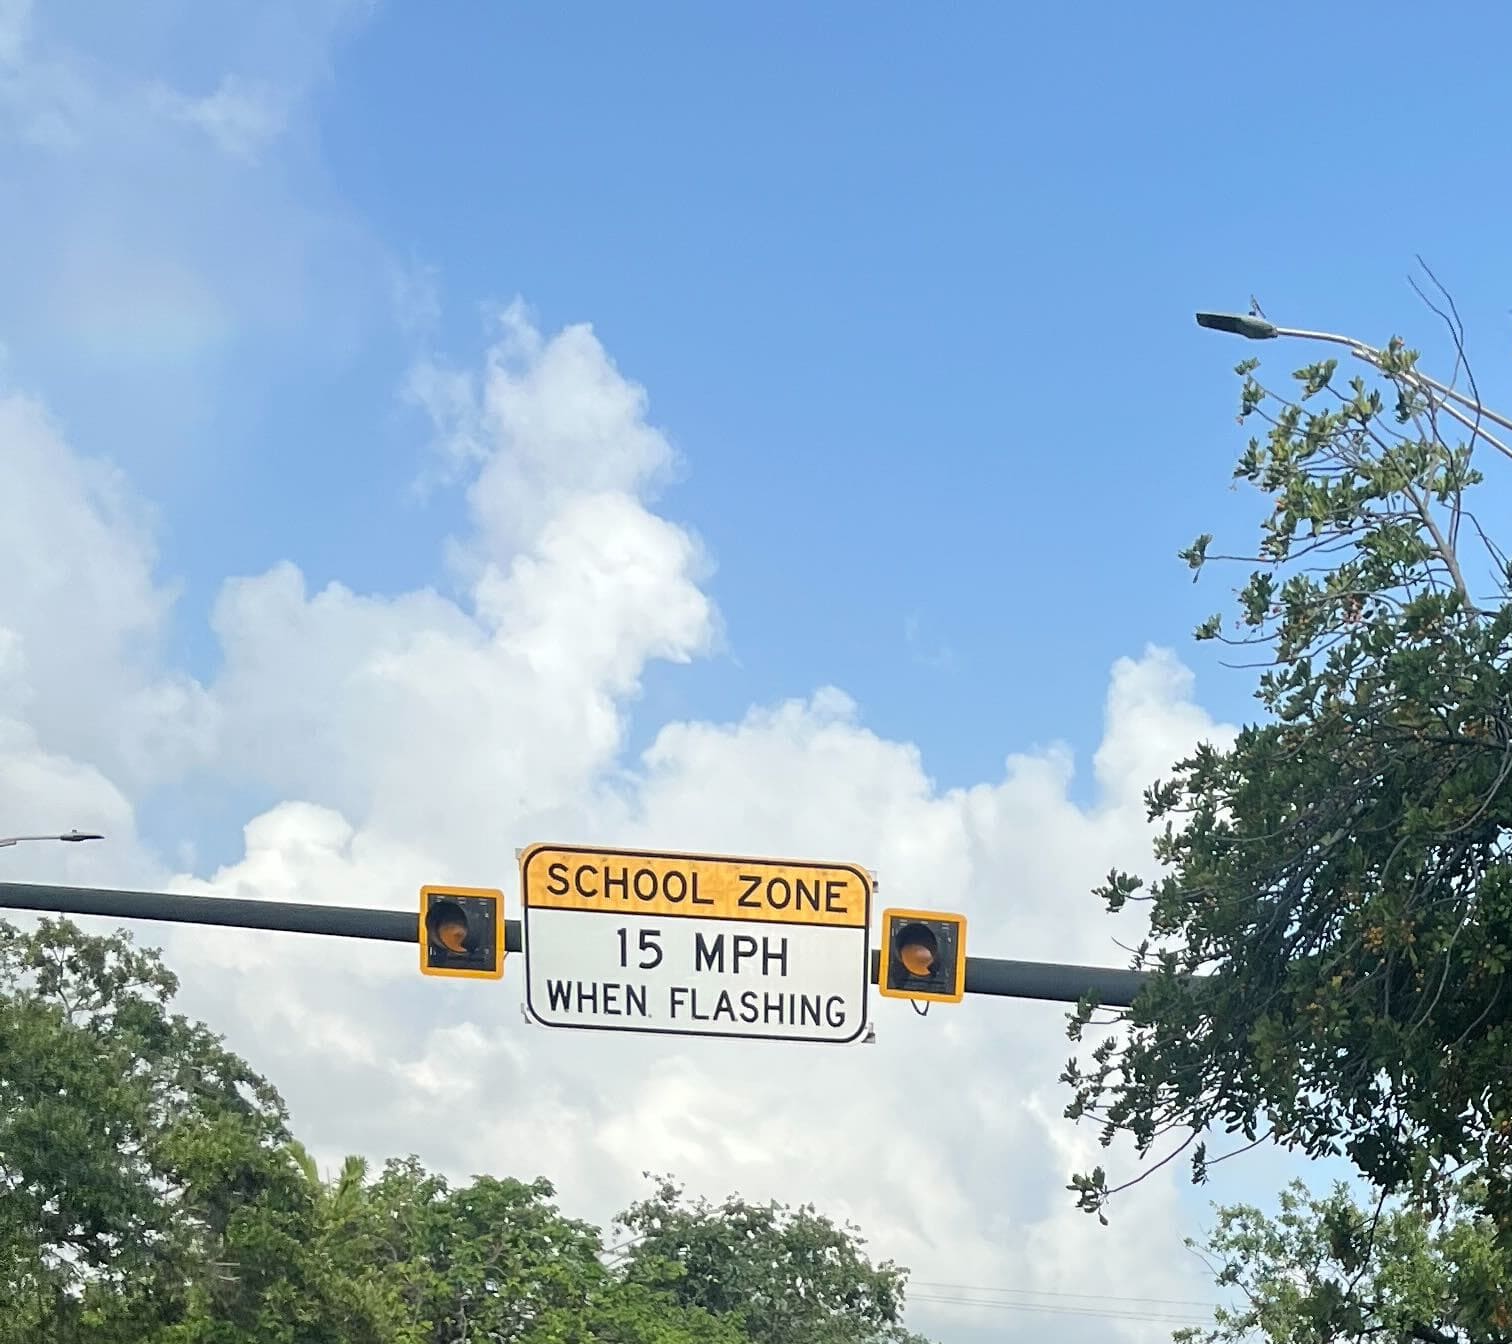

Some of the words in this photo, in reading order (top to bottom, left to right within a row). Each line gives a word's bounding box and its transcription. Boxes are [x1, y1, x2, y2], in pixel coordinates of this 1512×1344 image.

[547, 863, 714, 905] SCHOOL
[738, 875, 848, 913] ZONE
[617, 928, 664, 969] 15
[695, 932, 788, 977] MPH
[547, 979, 647, 1017] WHEN
[670, 987, 846, 1028] FLASHING
